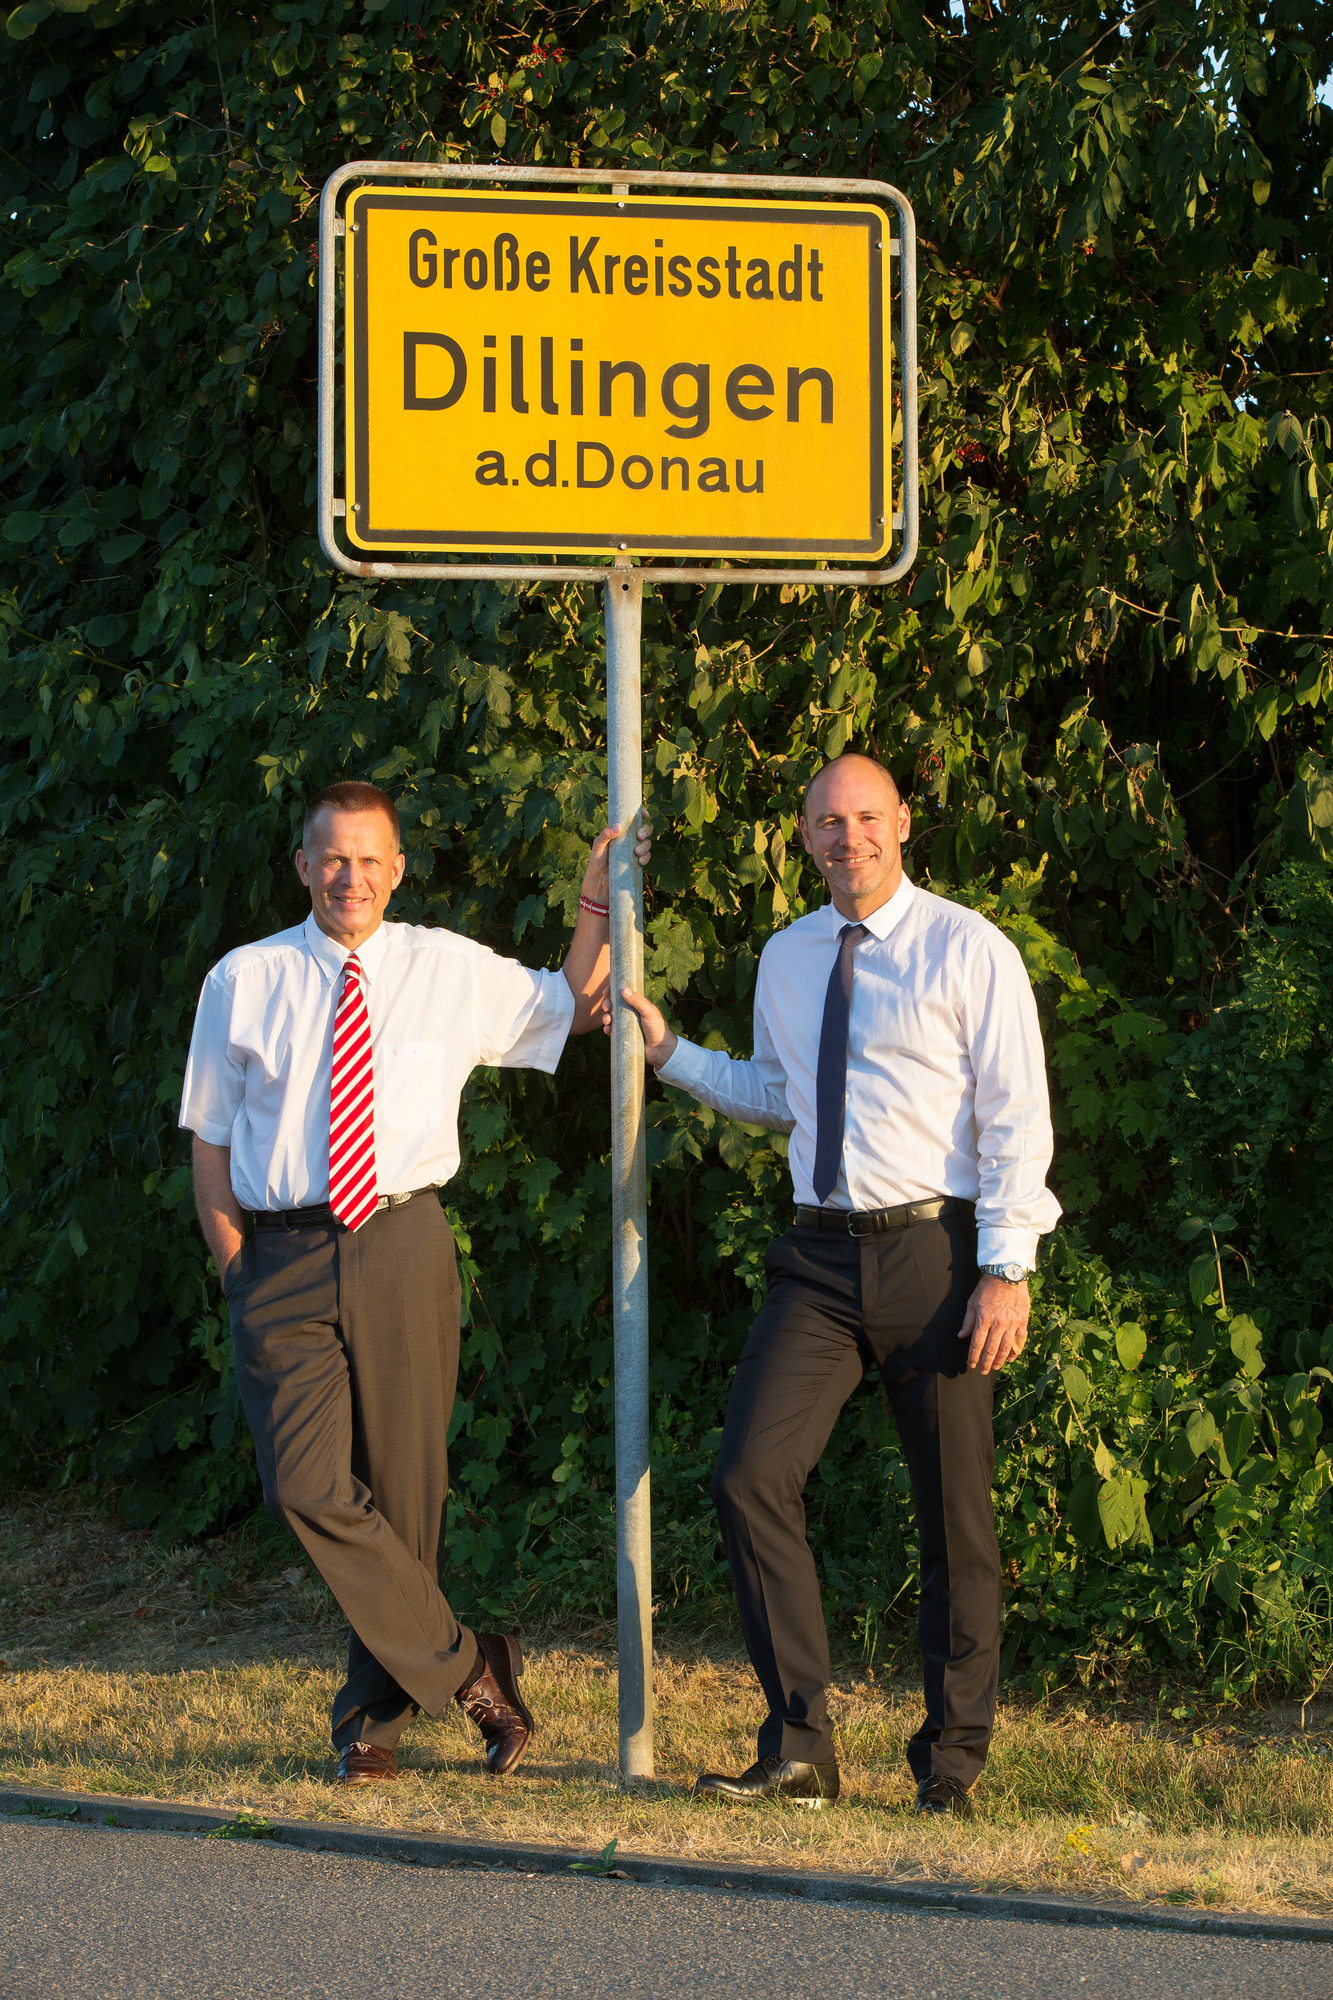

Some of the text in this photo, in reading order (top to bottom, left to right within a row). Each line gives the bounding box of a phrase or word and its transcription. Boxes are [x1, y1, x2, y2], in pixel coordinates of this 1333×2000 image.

[408, 228, 824, 302] Große Kreisstadt
[403, 331, 834, 439] Dillingen
